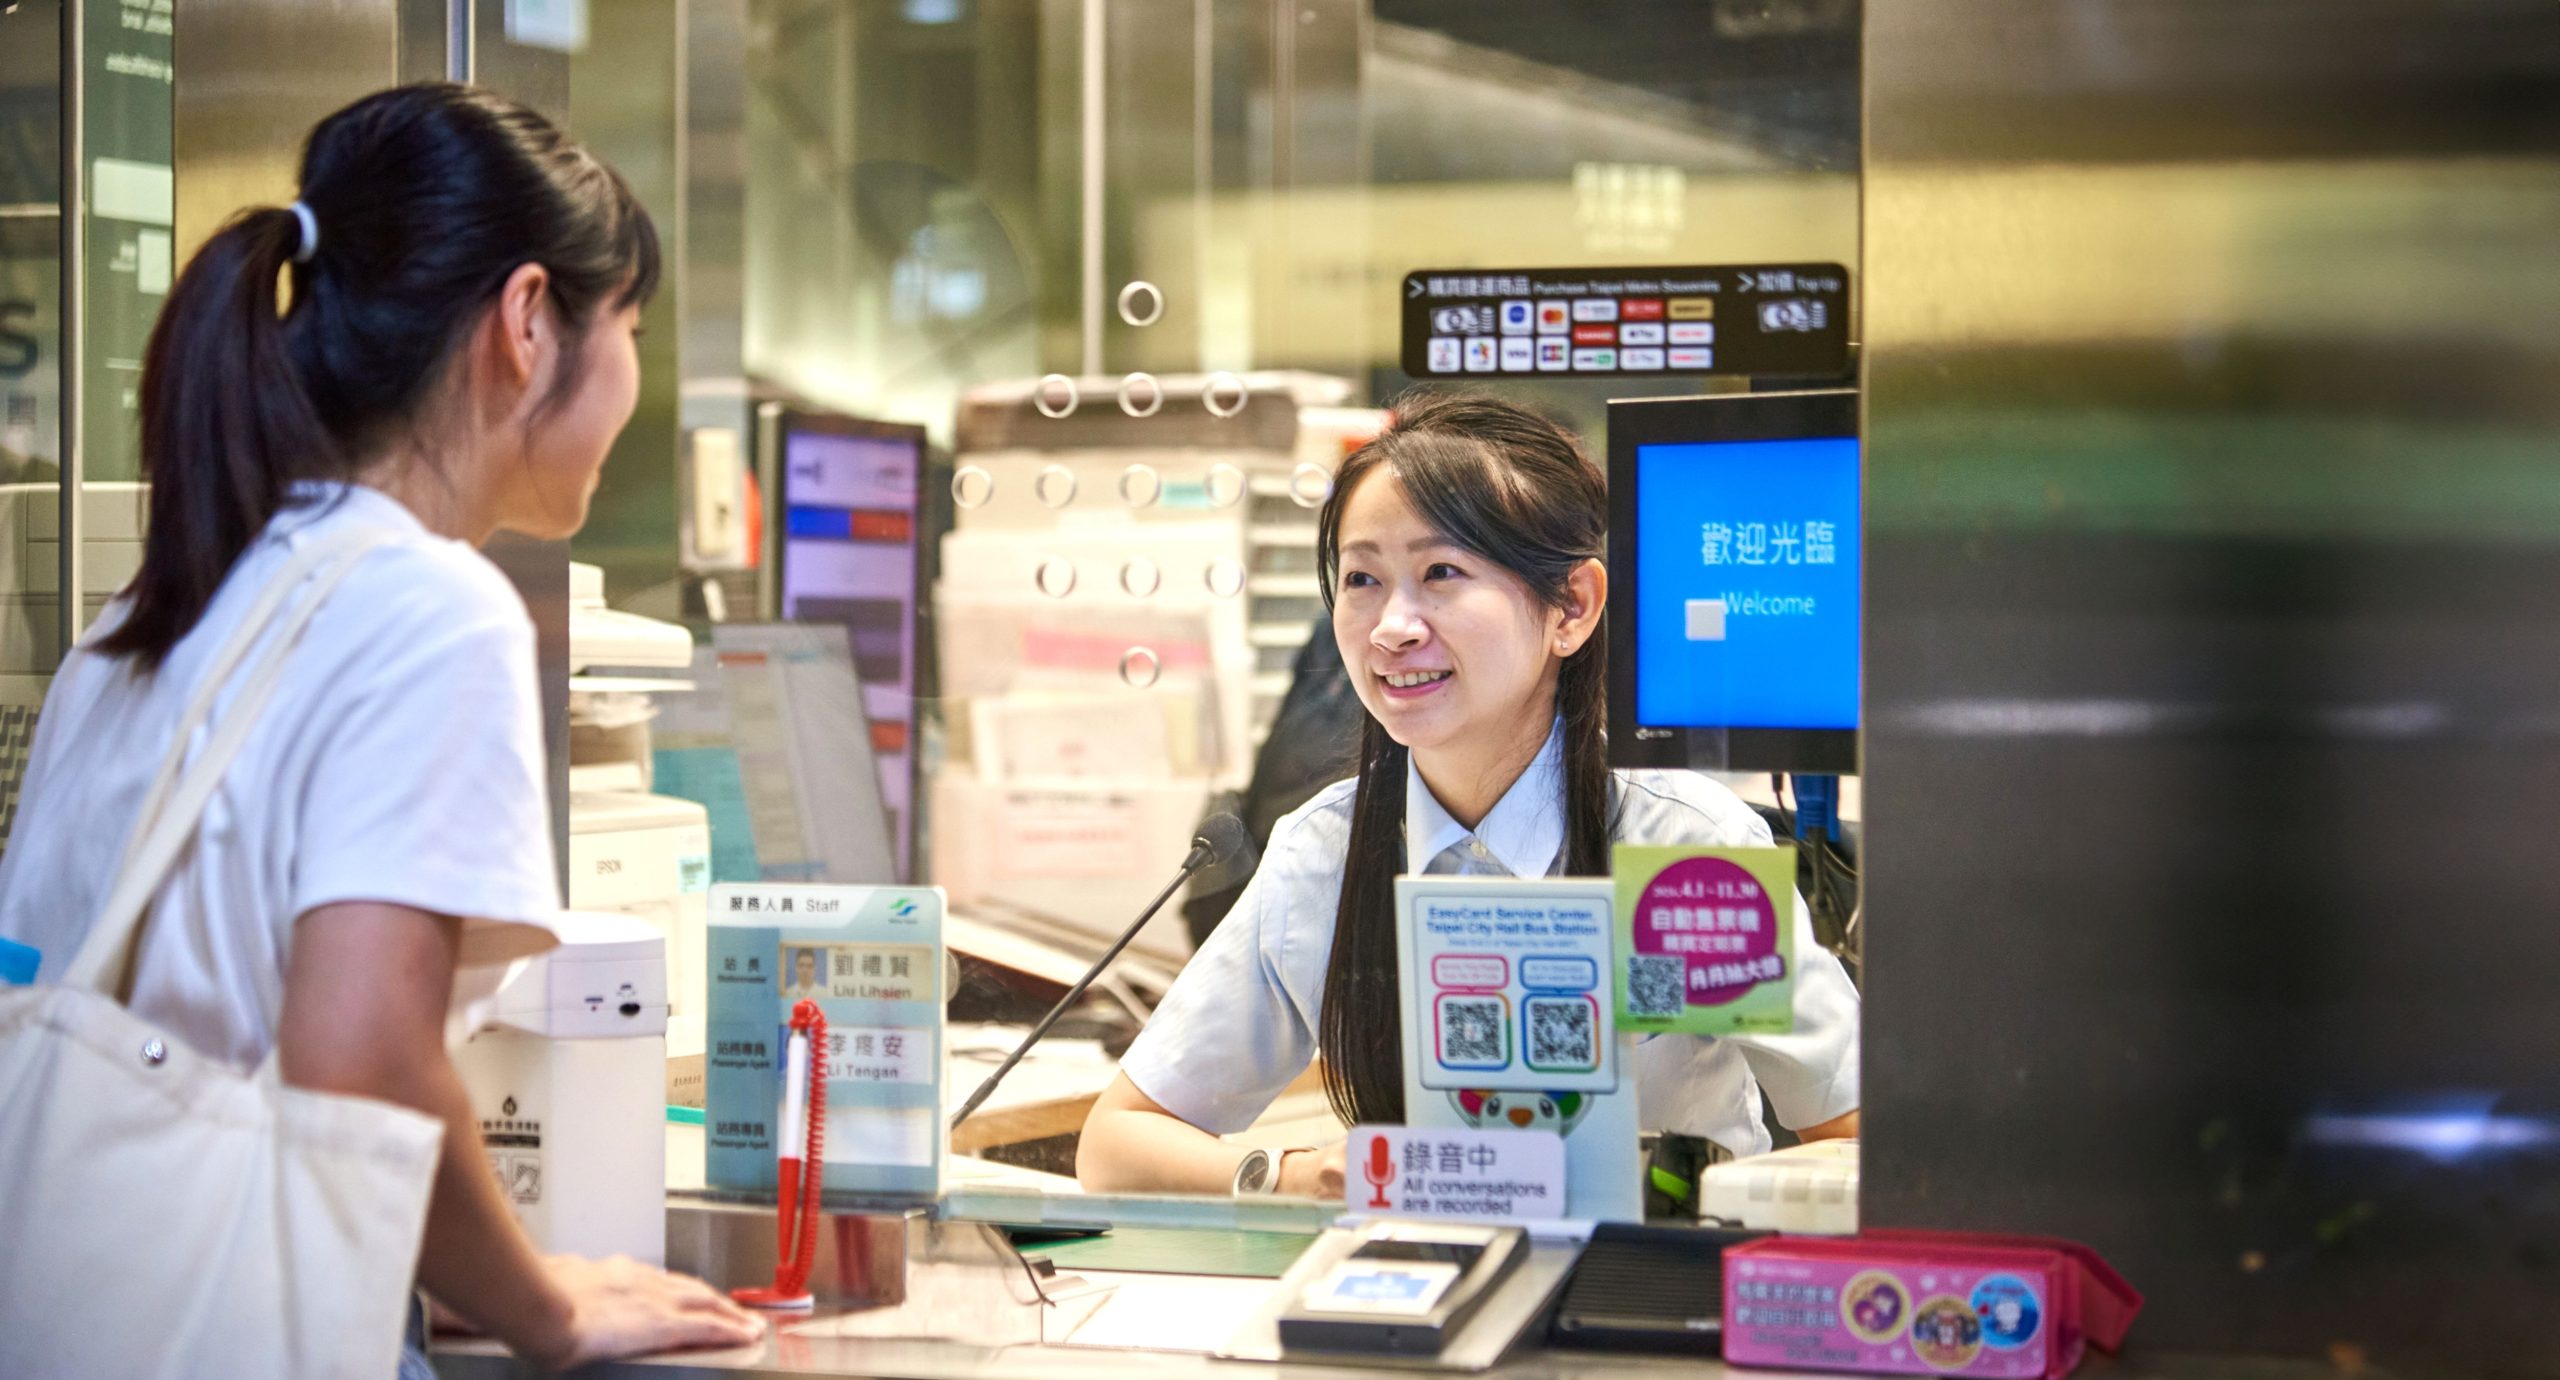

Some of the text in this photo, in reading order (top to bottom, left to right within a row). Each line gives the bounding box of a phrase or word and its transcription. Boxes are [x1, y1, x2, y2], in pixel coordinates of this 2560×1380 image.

[1590, 280, 1622, 295] Taipei
[1701, 521, 1836, 566] 歡迎光臨
[1720, 591, 1816, 616] Welcome
[730, 897, 795, 912] 服務人員
[806, 899, 840, 912] Staff
[1428, 908, 1491, 921] EasyCard
[1496, 909, 1544, 920] Service
[1428, 922, 1600, 936] Taipei City Hall Bus Station
[834, 954, 911, 978] 劉禮賢
[834, 985, 911, 999] Liu Lihsien
[847, 1064, 899, 1079] Tengan
[1403, 1141, 1497, 1175] 錄音中
[1403, 1177, 1547, 1198] All conversations
[1403, 1196, 1513, 1214] are recorded
